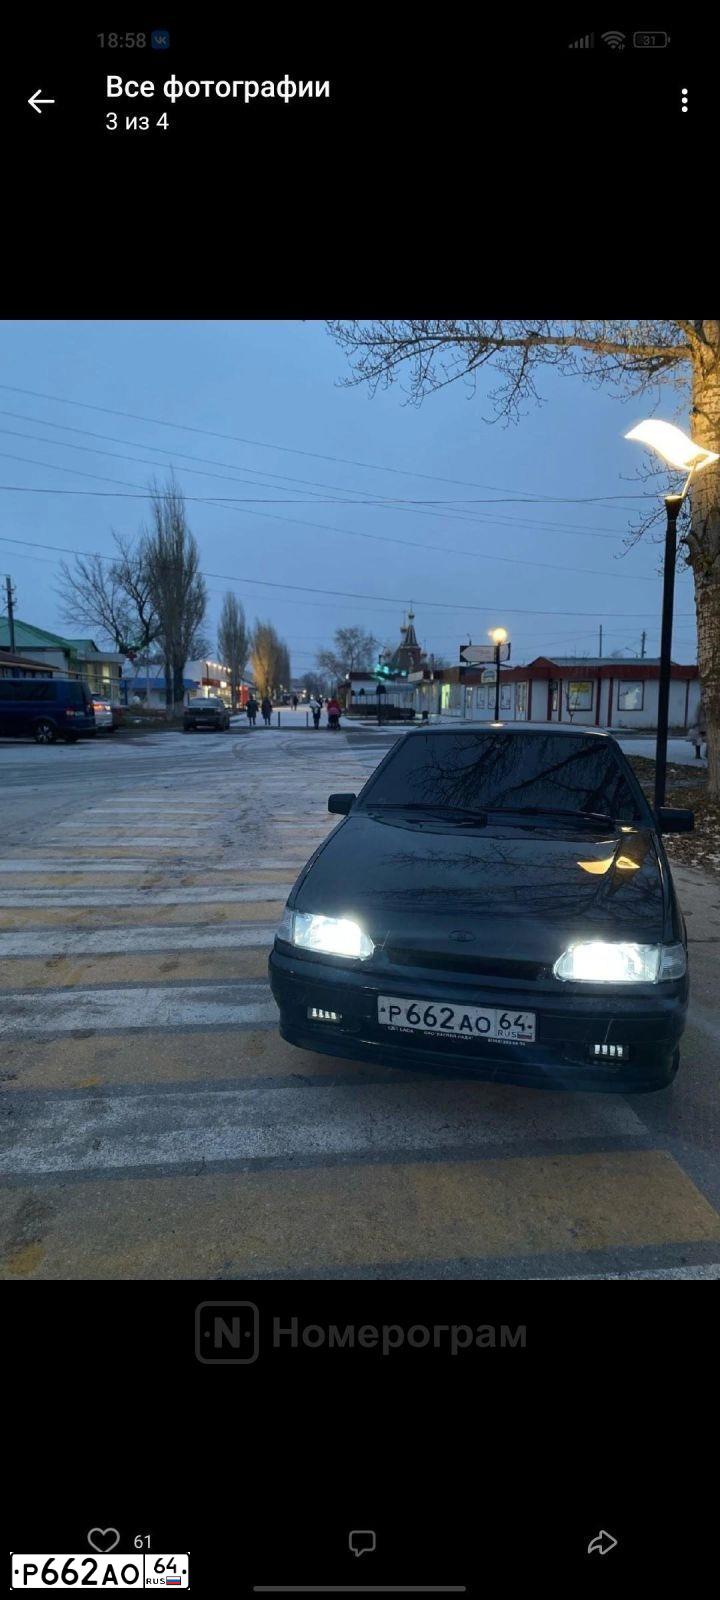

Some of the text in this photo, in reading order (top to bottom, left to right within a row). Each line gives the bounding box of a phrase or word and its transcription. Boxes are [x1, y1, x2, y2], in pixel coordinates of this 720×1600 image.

[389, 1003, 525, 1034] Р662АО 64
[497, 1029, 517, 1039] RUS
